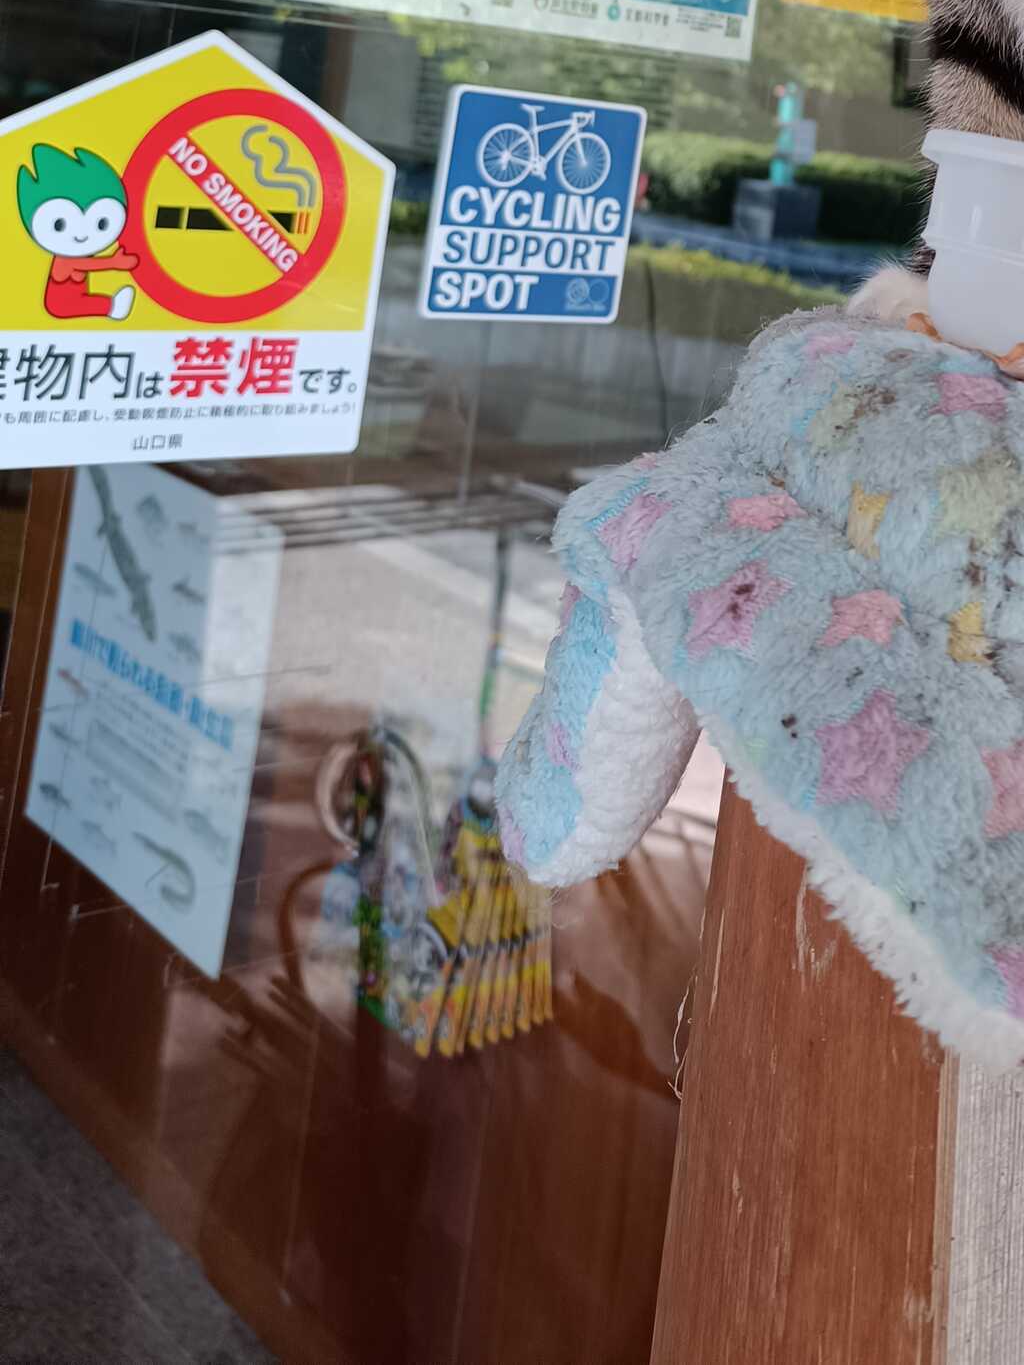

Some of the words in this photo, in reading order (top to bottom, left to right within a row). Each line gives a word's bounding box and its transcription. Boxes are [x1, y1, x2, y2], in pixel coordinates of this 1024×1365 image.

[168, 135, 207, 179] NO
[200, 170, 301, 275] SMOKING
[447, 186, 623, 235] CYCLING
[442, 230, 615, 272] SUPPORT
[434, 272, 539, 313] SPOT
[0, 335, 358, 403] 物内は禁煙です。
[132, 433, 184, 451] 山口県
